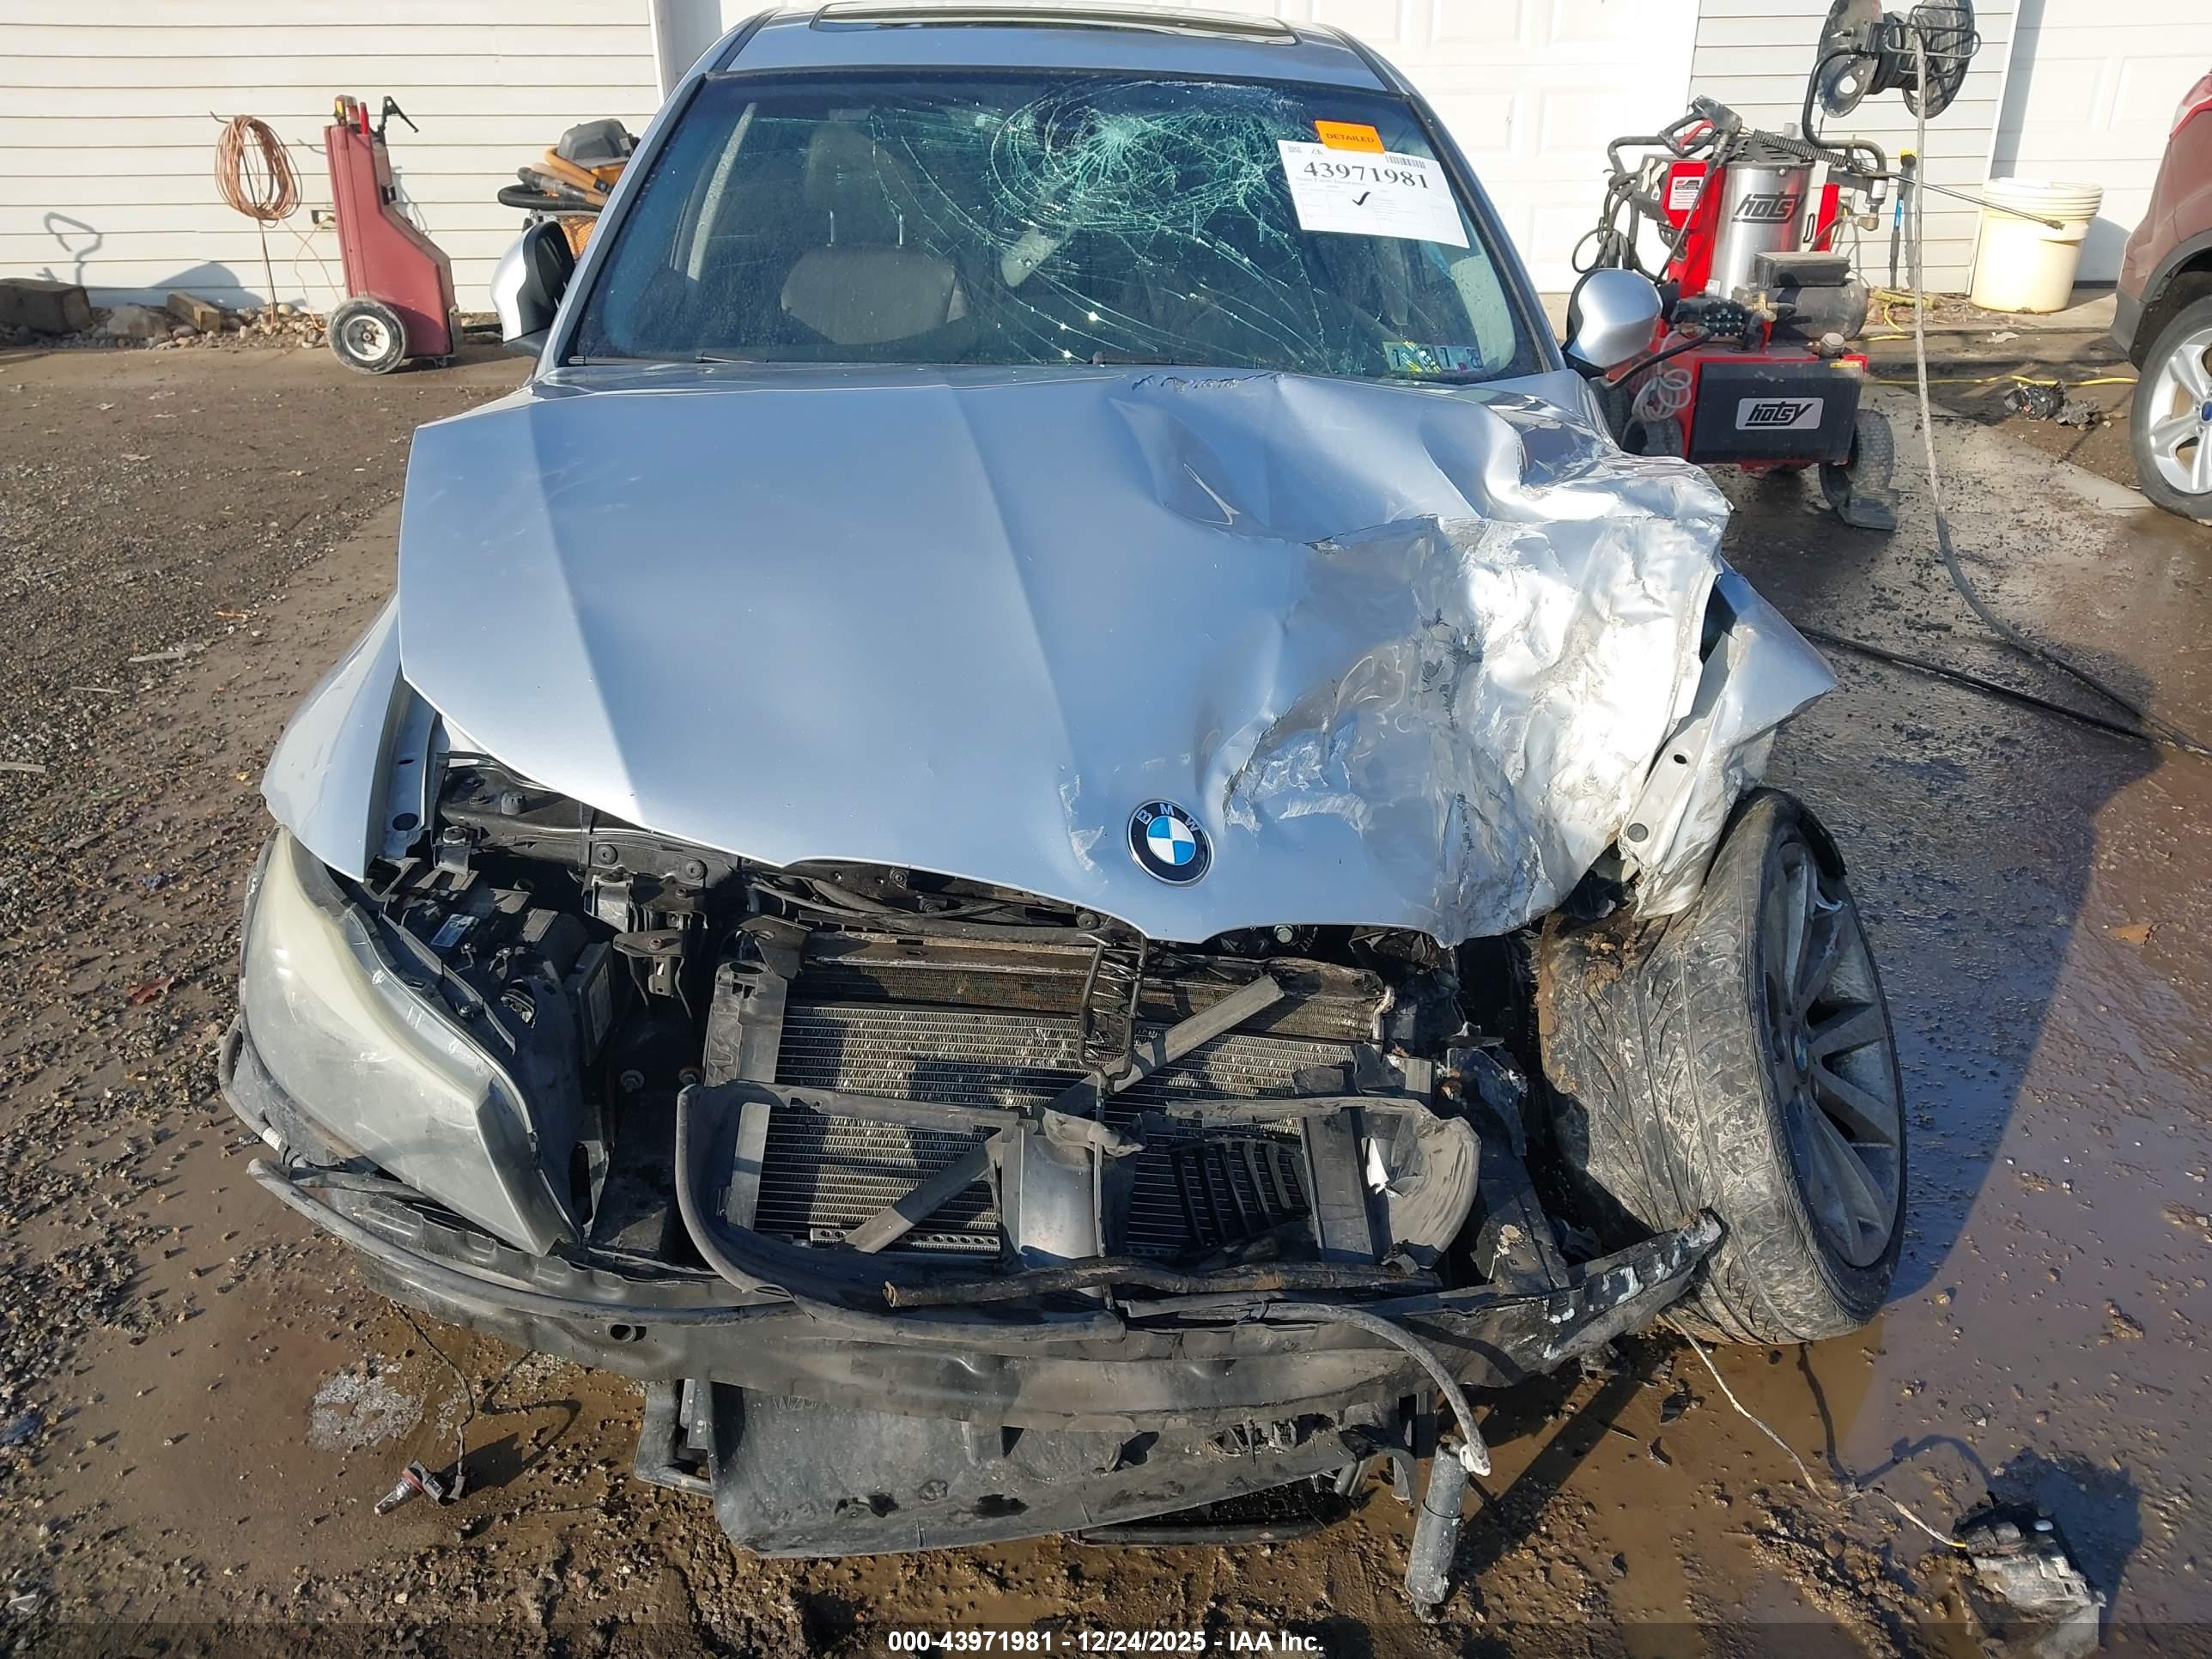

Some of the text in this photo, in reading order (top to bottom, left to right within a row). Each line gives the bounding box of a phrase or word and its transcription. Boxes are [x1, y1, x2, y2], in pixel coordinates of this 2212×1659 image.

[1326, 132, 1375, 143] DETAILED
[1304, 161, 1429, 189] 43971981
[1731, 191, 1806, 224] hotsy
[1746, 401, 1814, 426] hotsy
[1136, 803, 1200, 832] BMW
